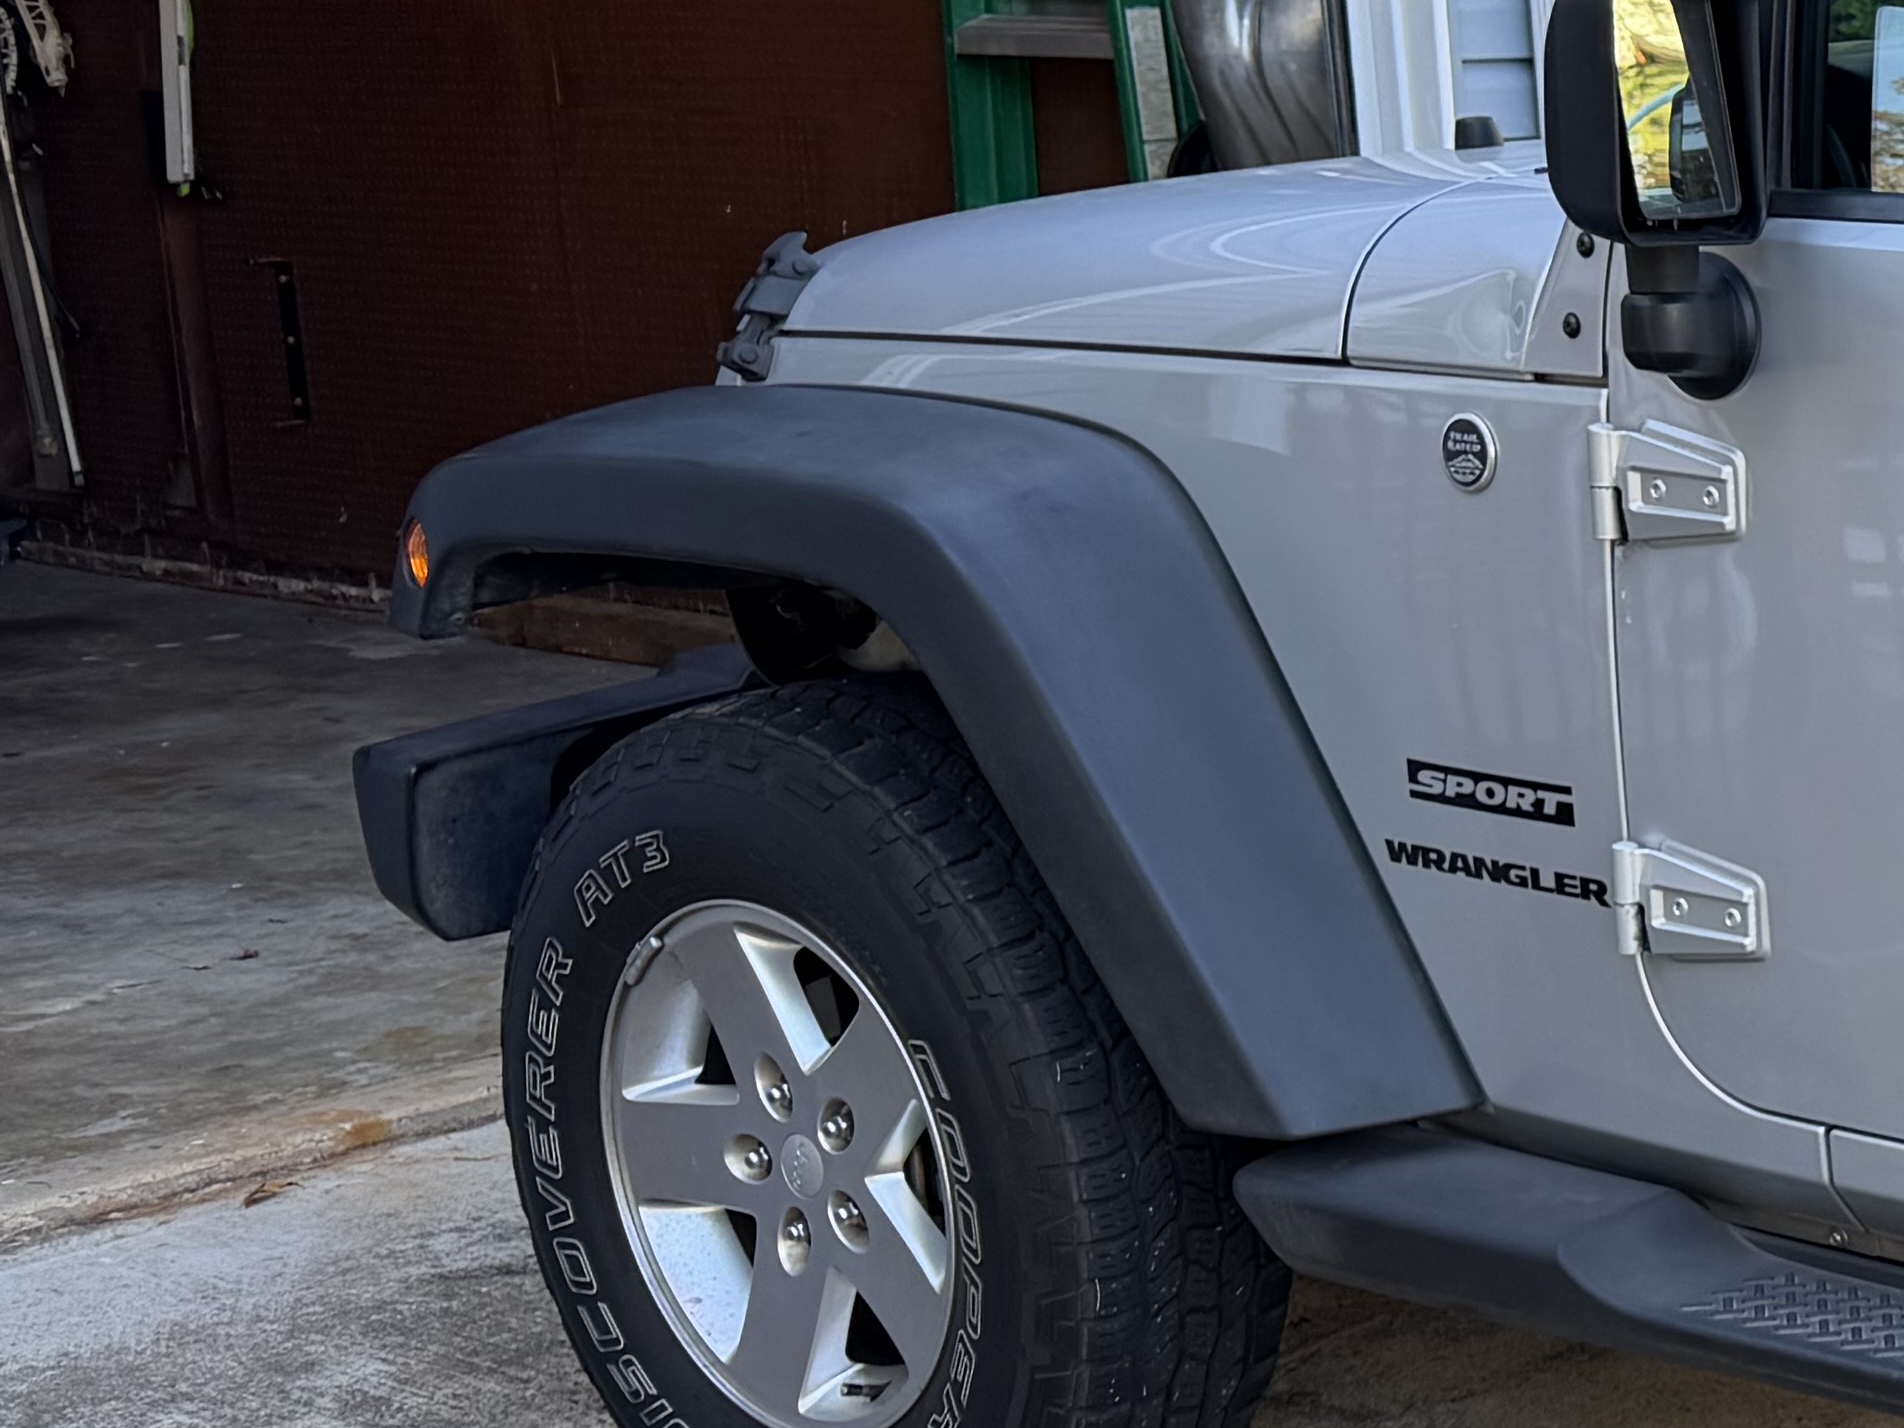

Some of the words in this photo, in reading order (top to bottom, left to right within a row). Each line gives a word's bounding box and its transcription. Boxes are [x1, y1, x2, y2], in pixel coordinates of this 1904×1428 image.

[1447, 439, 1481, 452] RATED
[1450, 431, 1480, 443] TRAIL
[1409, 769, 1573, 816] SPORT
[573, 829, 671, 927] AT3
[1385, 838, 1612, 908] WRANGLER
